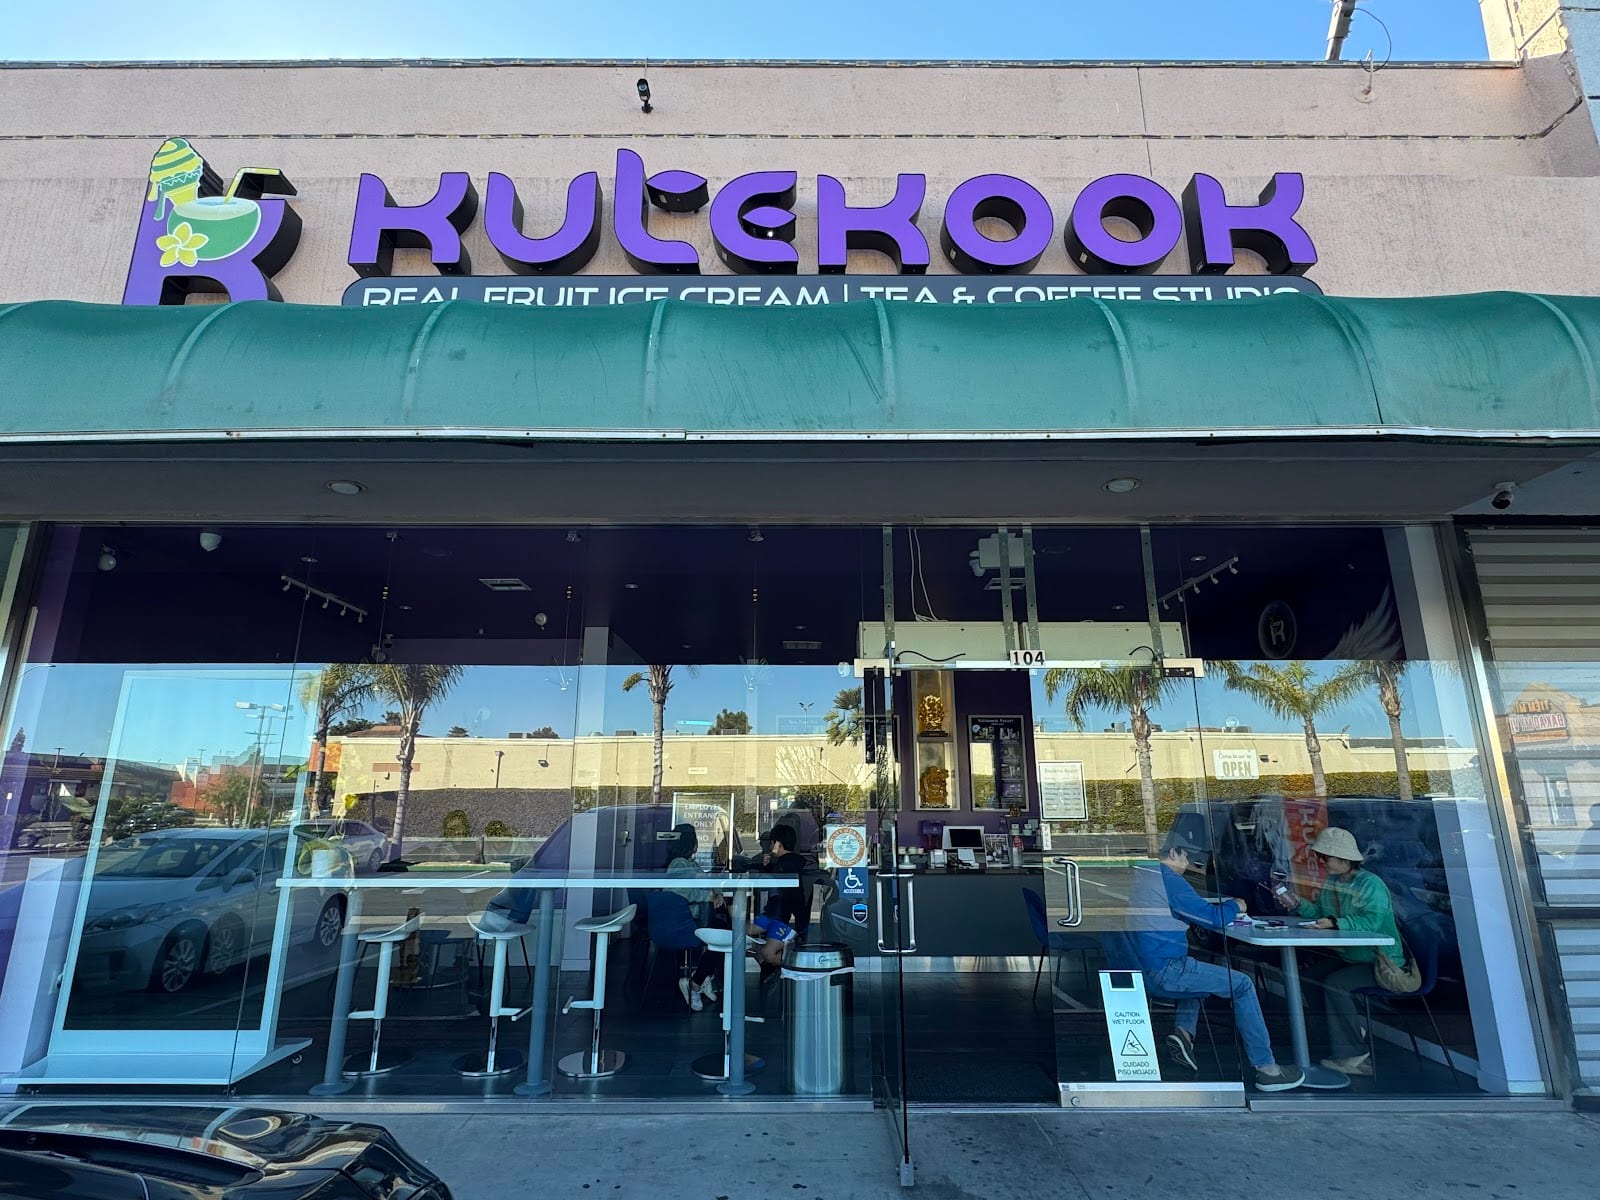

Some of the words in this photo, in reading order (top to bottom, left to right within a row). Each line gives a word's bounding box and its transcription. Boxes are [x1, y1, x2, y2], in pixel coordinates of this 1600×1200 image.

[483, 286, 599, 306] FRUIT
[608, 286, 669, 305] ICE
[679, 286, 830, 306] CREAM
[860, 286, 938, 303] TEA
[1153, 286, 1300, 302] STUD
[1013, 651, 1045, 666] 104
[1222, 761, 1252, 777] OPEN
[693, 820, 714, 828] ONLY
